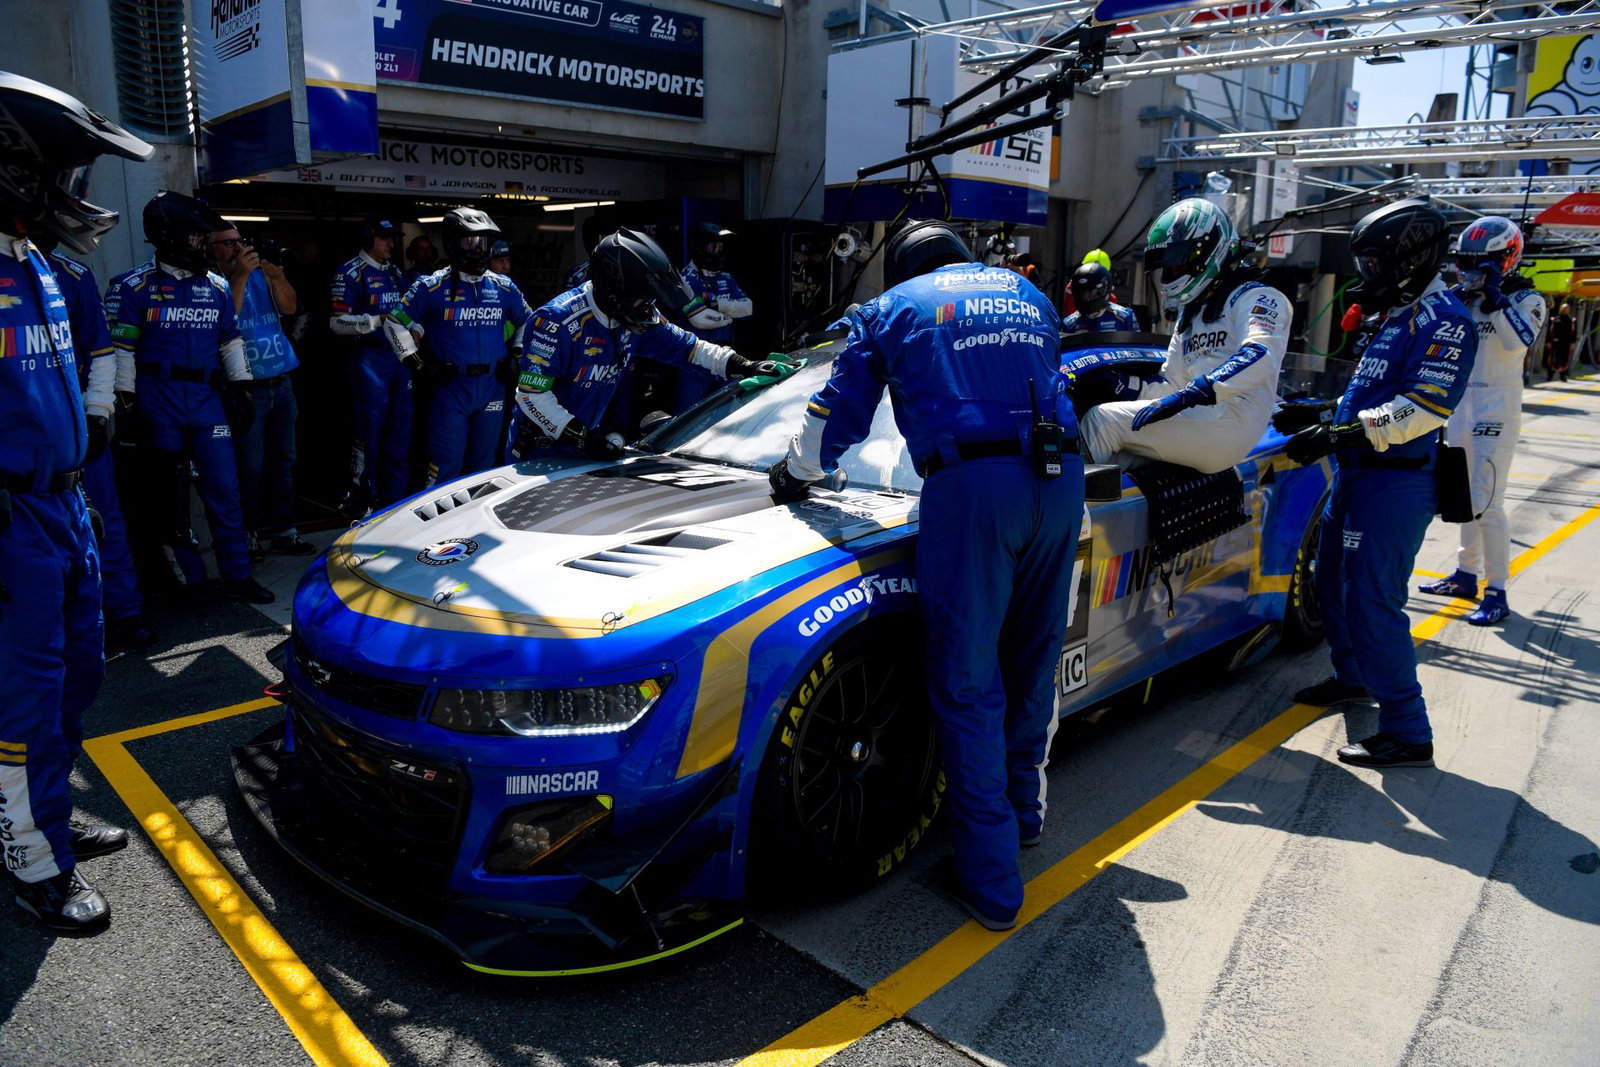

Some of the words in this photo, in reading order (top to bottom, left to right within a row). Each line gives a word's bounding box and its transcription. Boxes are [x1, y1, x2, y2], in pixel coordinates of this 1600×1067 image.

[487, 0, 561, 14] OVATIVE
[563, 3, 589, 19] CAR
[220, 6, 260, 37] MOTORSPORTS
[609, 12, 641, 26] WEC
[661, 33, 676, 42] MANS
[431, 38, 554, 77] HENDRICK
[558, 57, 705, 98] MOTORSPORTS
[1005, 136, 1044, 164] 56
[431, 145, 585, 176] MOTORSPORTS
[339, 174, 396, 185] BUTTON
[442, 180, 498, 190] JOHNSON
[540, 185, 622, 198] ROCKENFELLER
[933, 271, 1019, 287] Hendrick
[166, 307, 220, 323] NASCAR
[459, 307, 503, 321] NASCAR
[965, 297, 1042, 322] NASCAR
[160, 321, 171, 329] TO
[177, 321, 187, 329] LE
[190, 321, 213, 330] MANS
[545, 321, 561, 334] 75
[957, 318, 974, 328] TO
[985, 316, 999, 324] LE
[1006, 316, 1036, 327] MANS
[530, 338, 557, 354] Hendrick
[953, 327, 1044, 351] GOODYEAR
[1440, 336, 1462, 344] MANS
[1443, 346, 1463, 361] 75
[21, 358, 37, 372] TO
[1073, 354, 1101, 369] BUTTON
[519, 373, 548, 388] PITLANE
[1417, 367, 1457, 383] Hendrick
[1393, 408, 1416, 423] 56
[212, 428, 232, 439] 56
[1472, 426, 1504, 437] 56
[797, 573, 919, 637] GOODYEA
[1064, 653, 1084, 688] IC
[780, 649, 836, 749] EAGLE
[526, 769, 599, 794] NASCAR
